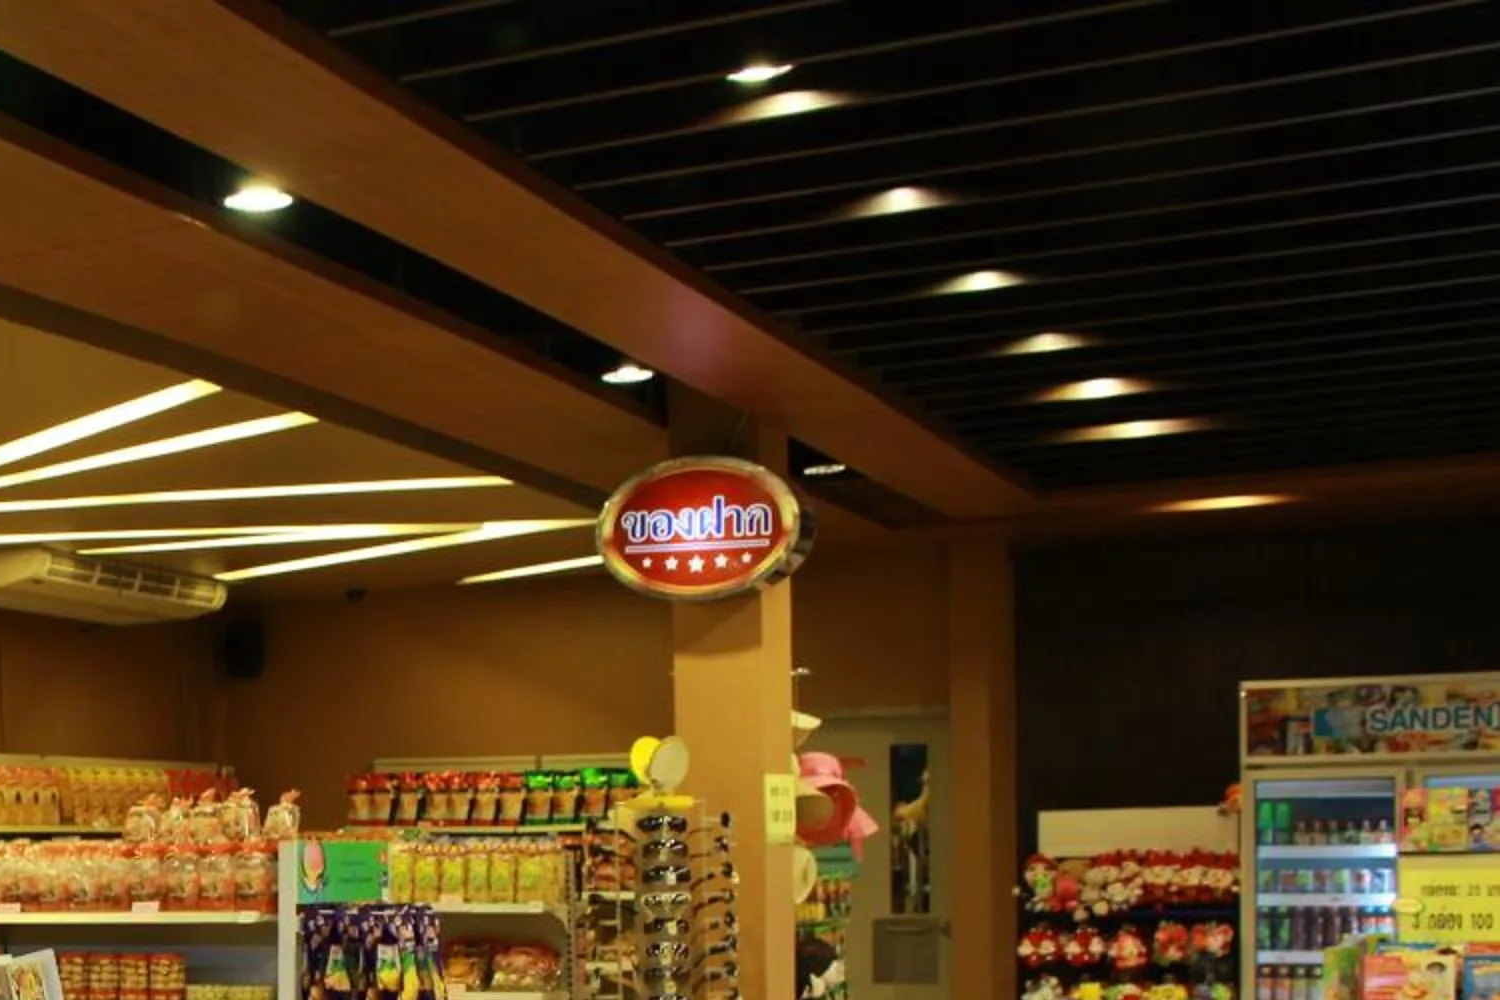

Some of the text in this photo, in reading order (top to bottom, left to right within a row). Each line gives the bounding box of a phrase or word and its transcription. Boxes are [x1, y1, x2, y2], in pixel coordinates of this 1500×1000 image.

[622, 496, 771, 542] ของฝาก
[1369, 704, 1494, 732] SANDEN
[1470, 912, 1493, 930] 100
